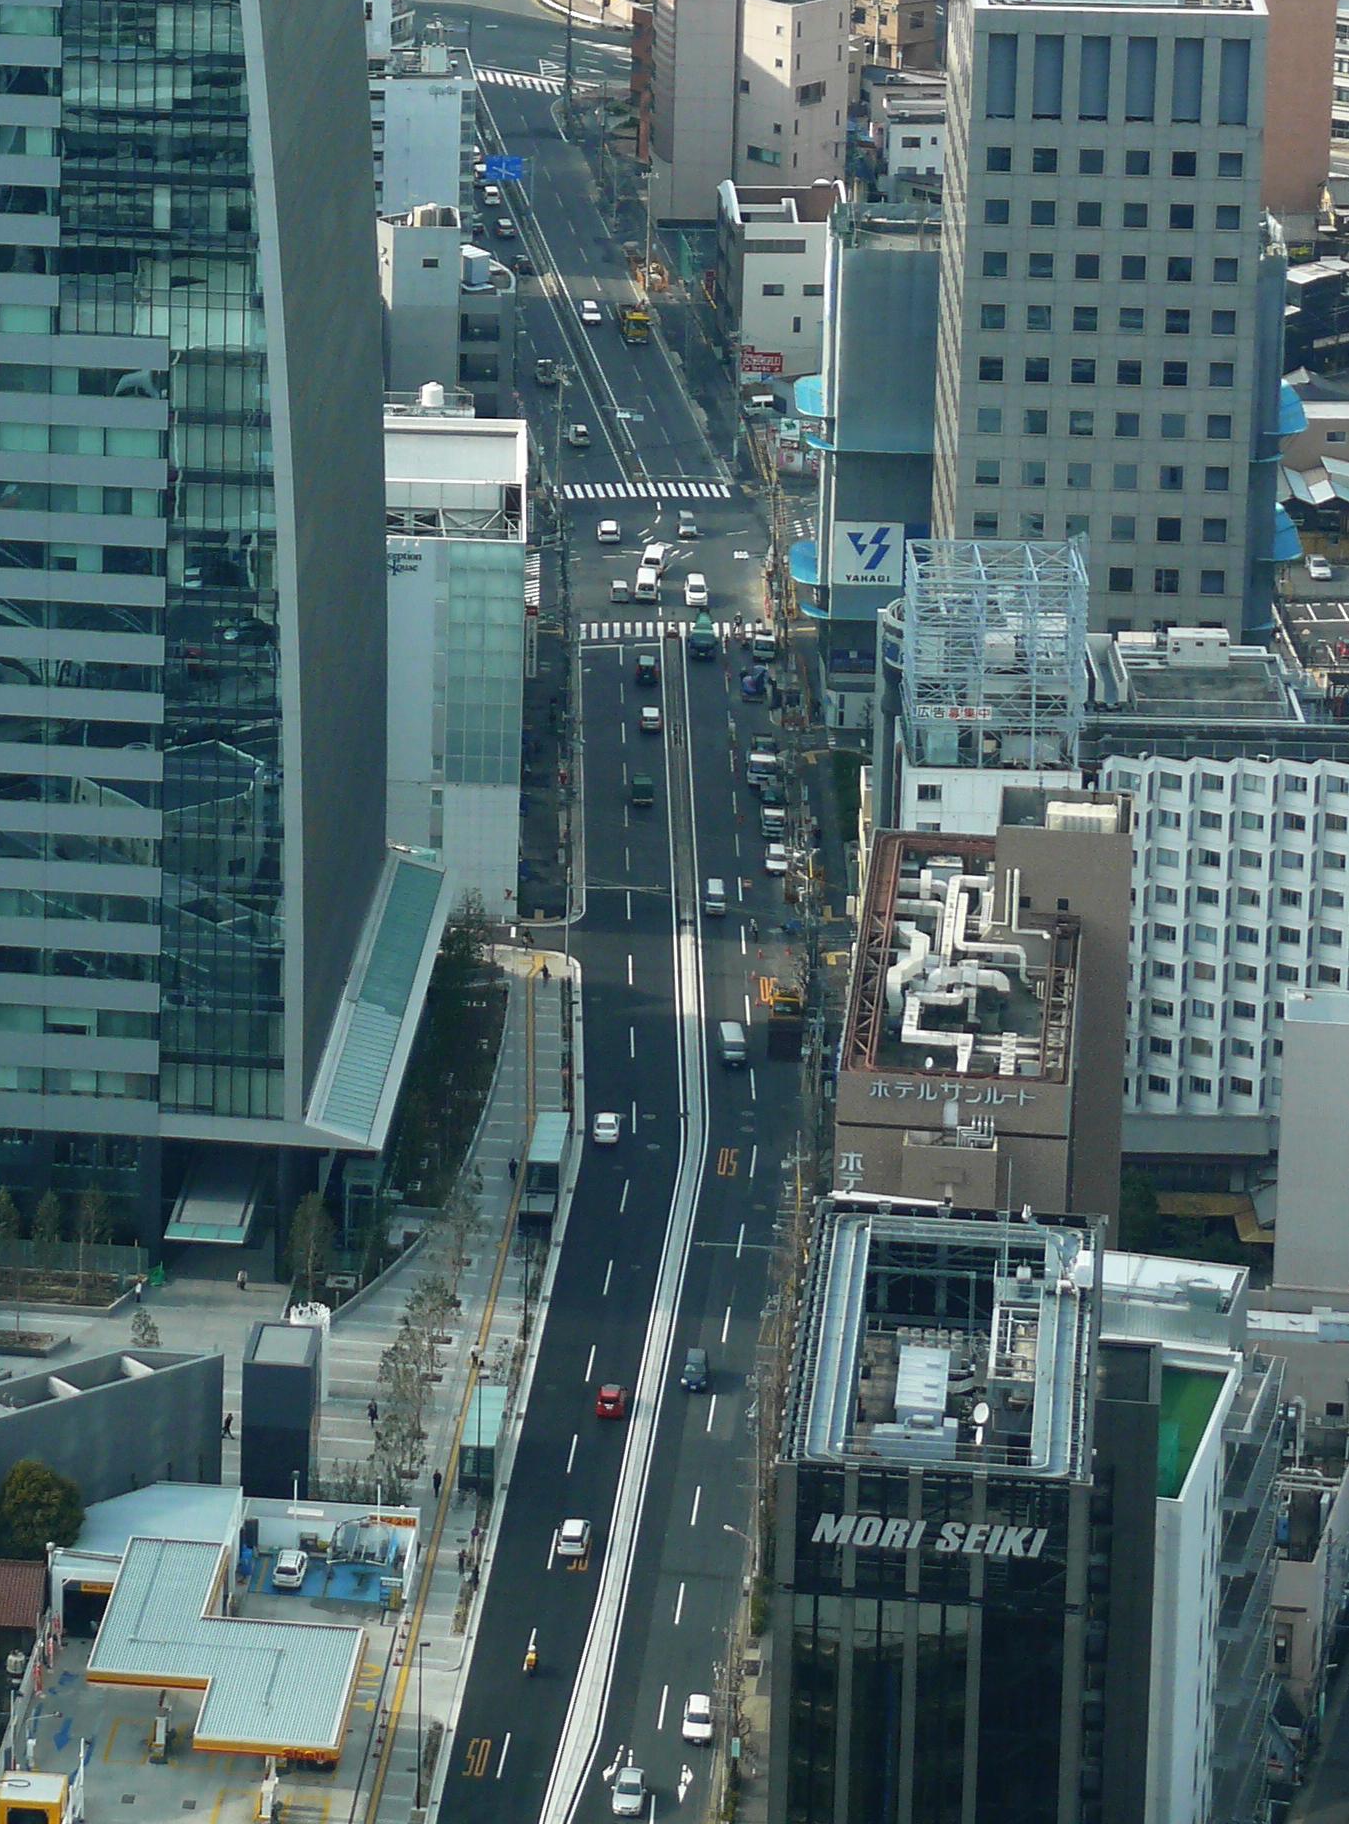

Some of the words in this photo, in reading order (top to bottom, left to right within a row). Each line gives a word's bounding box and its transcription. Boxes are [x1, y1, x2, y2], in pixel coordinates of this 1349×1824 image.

[845, 574, 891, 583] YAHAGI
[868, 1079, 1037, 1107] ホテルサンルート
[811, 1512, 927, 1550] MORI
[935, 1521, 1049, 1559] SEIKI
[462, 1738, 492, 1777] 50
